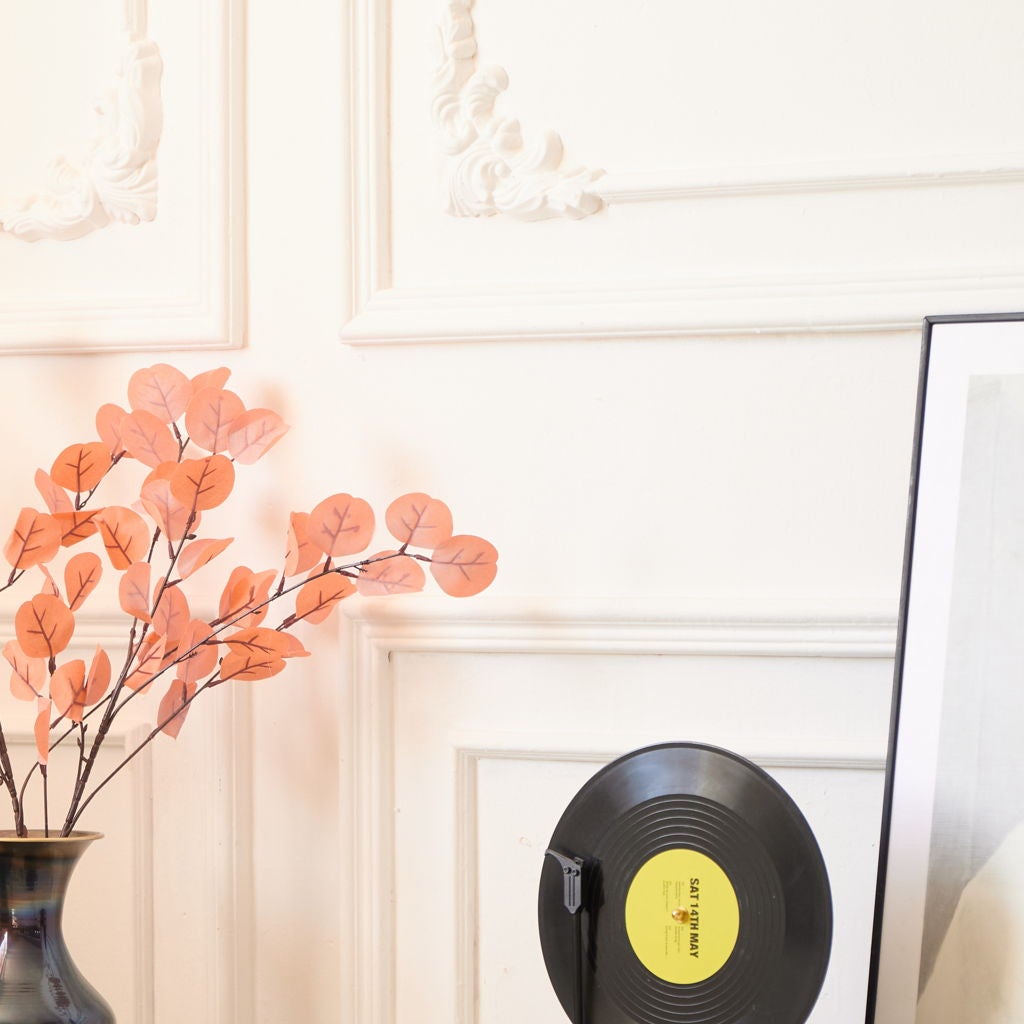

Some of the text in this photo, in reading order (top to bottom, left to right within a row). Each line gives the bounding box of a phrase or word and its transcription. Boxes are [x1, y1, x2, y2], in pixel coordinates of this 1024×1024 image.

[689, 878, 699, 959] SAT 14TH MAY
